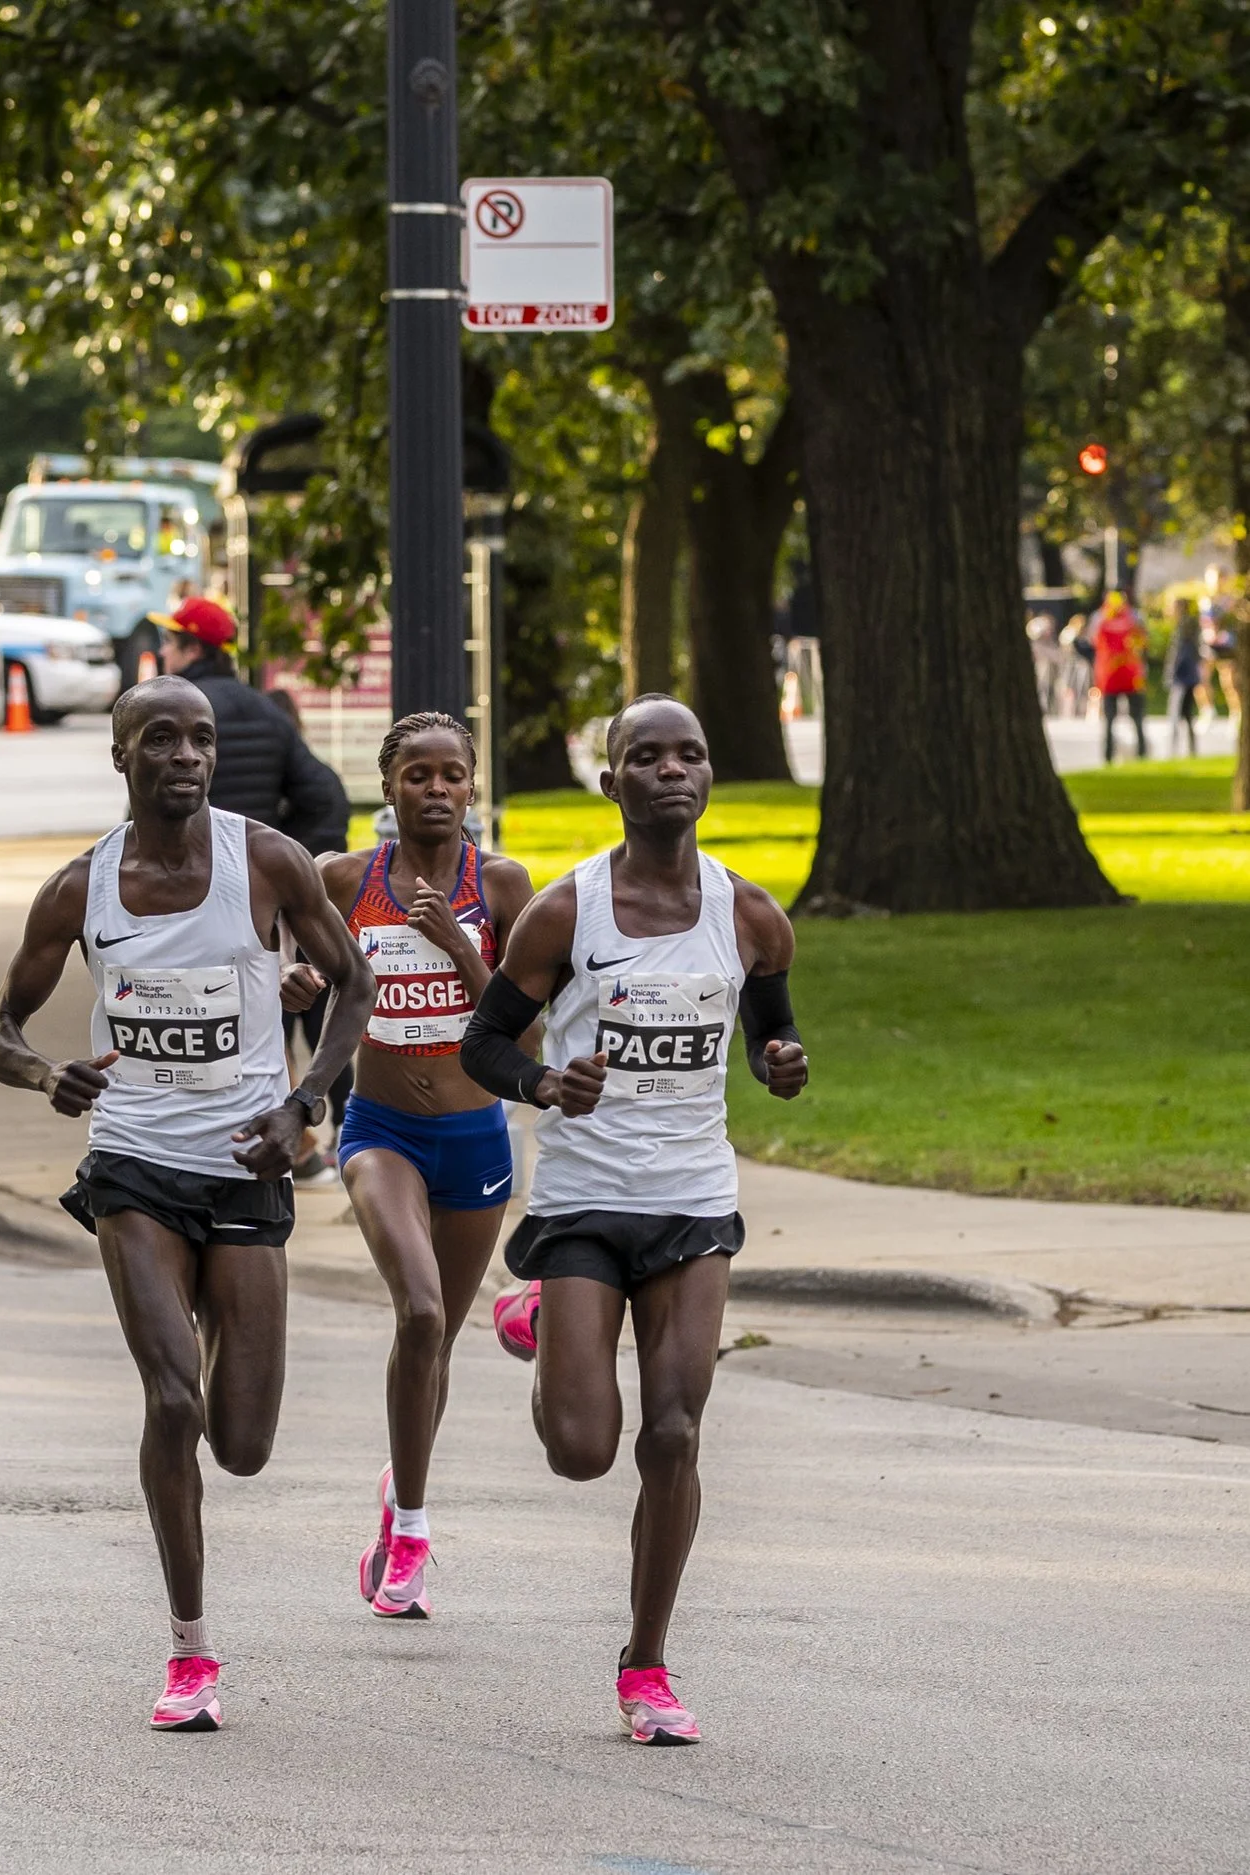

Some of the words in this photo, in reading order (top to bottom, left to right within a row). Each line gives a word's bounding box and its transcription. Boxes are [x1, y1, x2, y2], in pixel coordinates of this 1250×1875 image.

[476, 305, 523, 325] TOW
[535, 305, 599, 325] ZONE
[381, 941, 409, 949] Chicago
[381, 948, 416, 956] Marathon
[387, 961, 452, 972] 10.13.2019
[135, 983, 165, 993] Chicago
[135, 990, 173, 999] Marathon
[631, 989, 661, 998] Chicago
[630, 997, 668, 1005] Marathon
[138, 1005, 207, 1016] 10.13.2019
[632, 1013, 699, 1022] 10.13.2019
[114, 1023, 206, 1057] PACE
[215, 1022, 236, 1052] 6
[601, 1030, 694, 1065] PACE
[702, 1032, 720, 1062] 5
